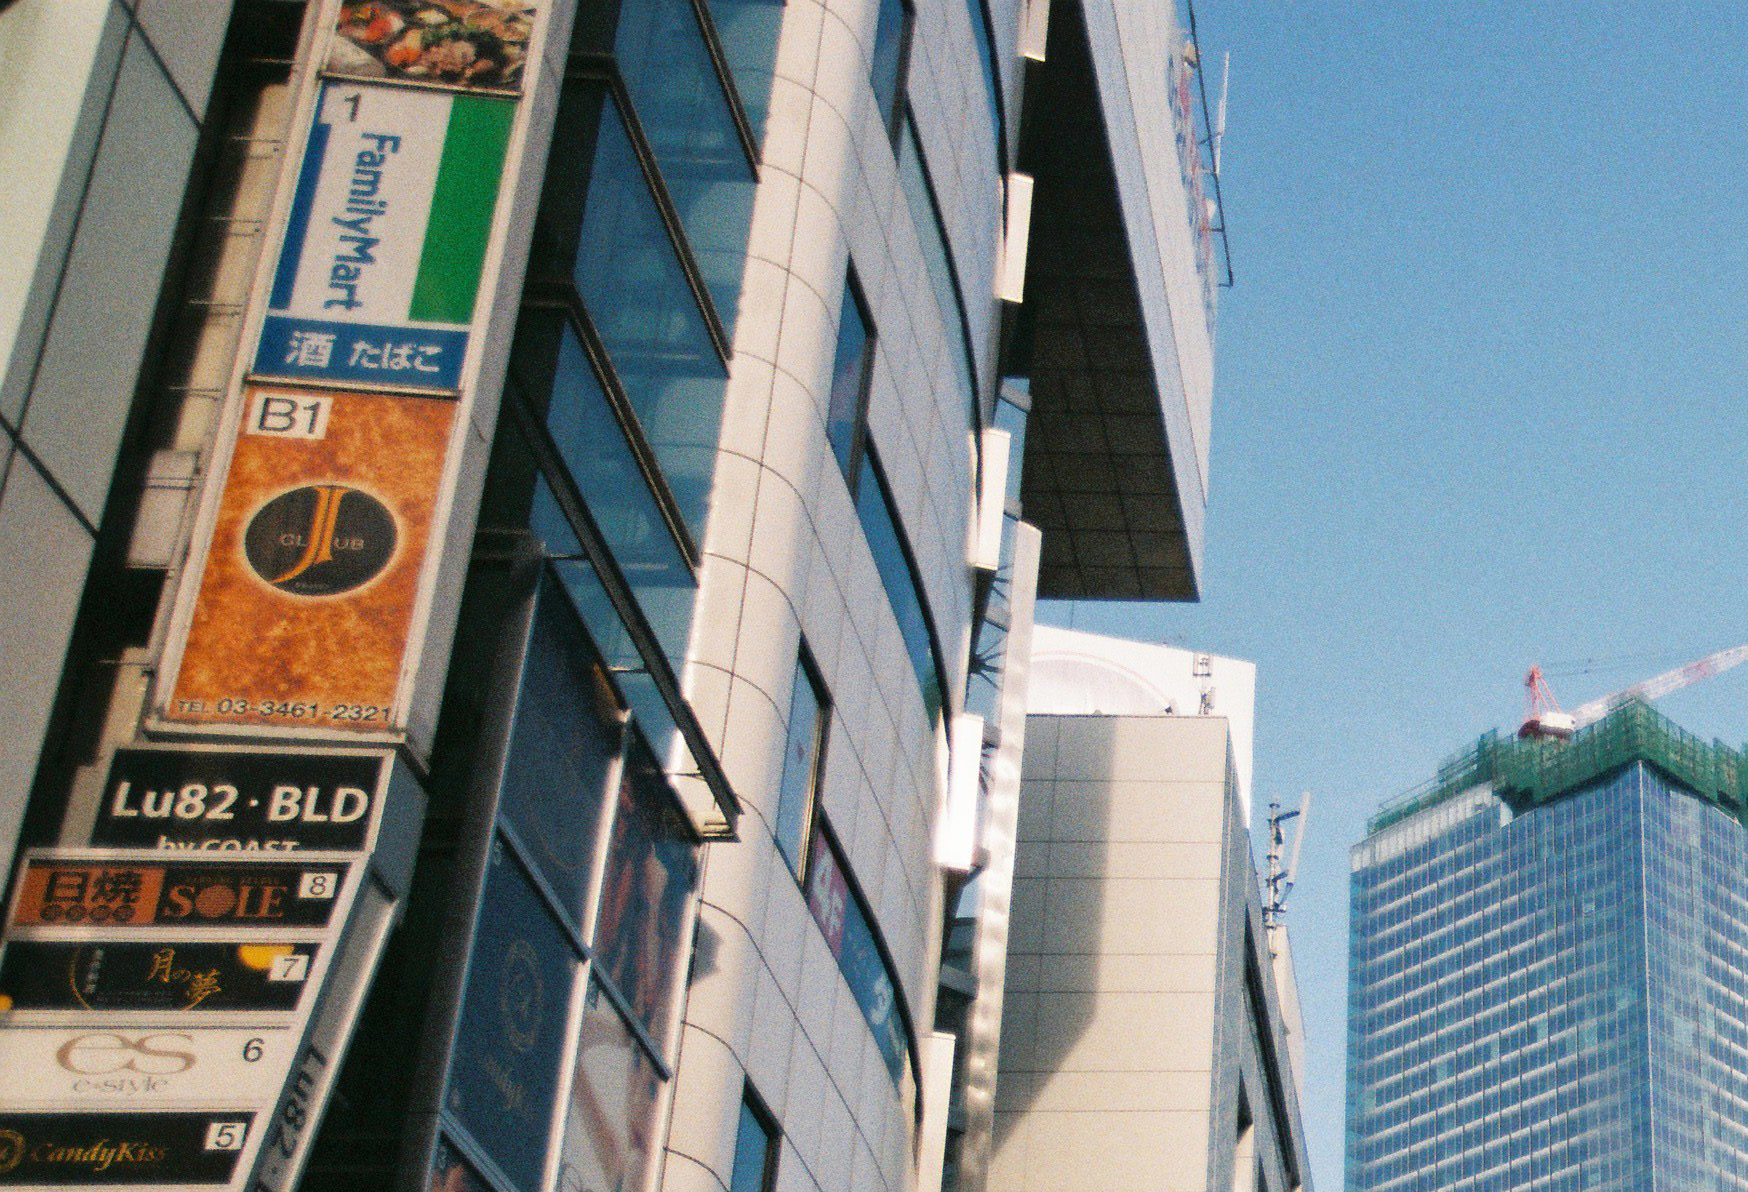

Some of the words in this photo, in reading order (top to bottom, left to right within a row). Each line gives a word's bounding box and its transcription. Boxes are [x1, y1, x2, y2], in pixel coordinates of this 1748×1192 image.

[344, 95, 359, 122] 1
[324, 131, 401, 311] FamilyMart
[285, 331, 336, 370] 酒
[349, 340, 442, 373] たばこ
[257, 397, 322, 435] B1
[177, 701, 209, 714] TEL
[216, 696, 392, 724] 03-3461-2321
[308, 875, 327, 896] 8
[147, 948, 222, 999] 月の夢
[281, 957, 302, 979] 7
[243, 1038, 265, 1063] 6
[214, 1125, 236, 1149] 5
[30, 1138, 166, 1172] CandyKiss
